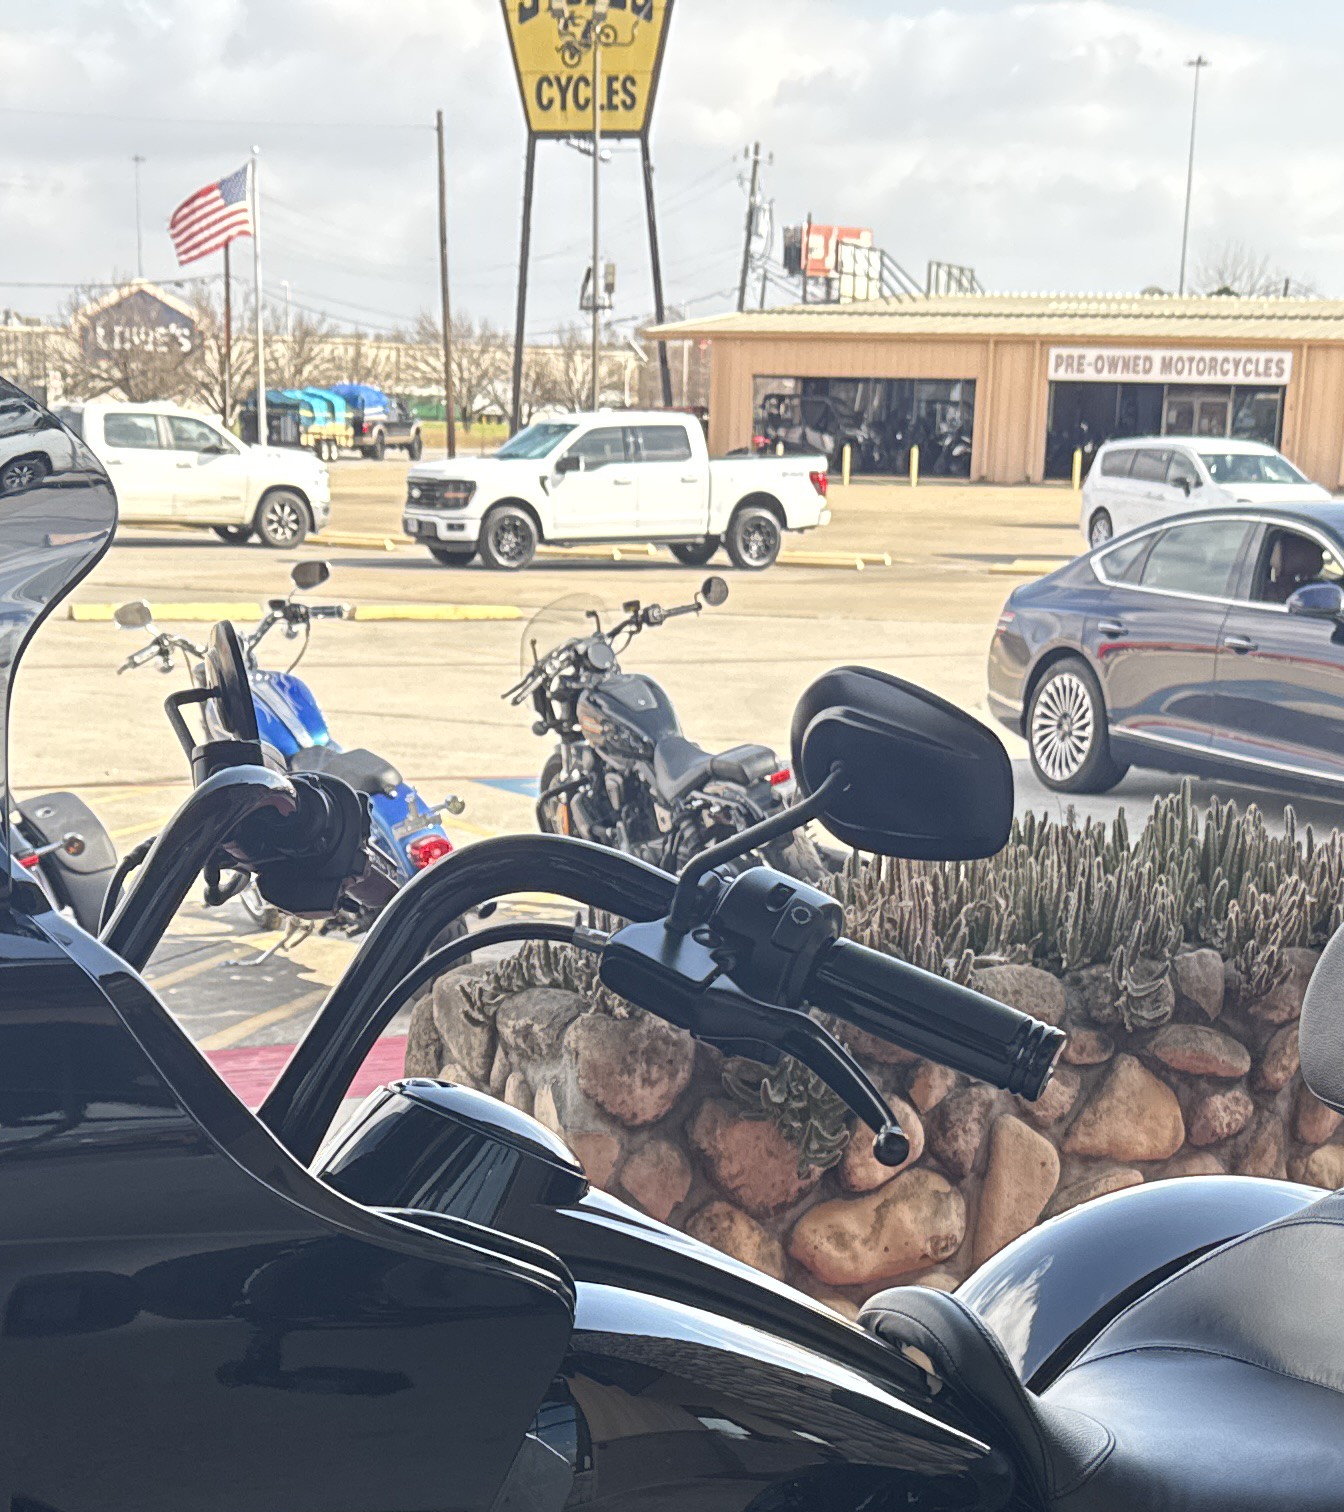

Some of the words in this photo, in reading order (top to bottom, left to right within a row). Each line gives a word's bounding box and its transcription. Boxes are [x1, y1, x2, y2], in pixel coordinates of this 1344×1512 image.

[535, 75, 637, 111] CYCES
[1053, 353, 1154, 376] PRE-OWNED
[1159, 355, 1286, 378] MOTORCYCLES
